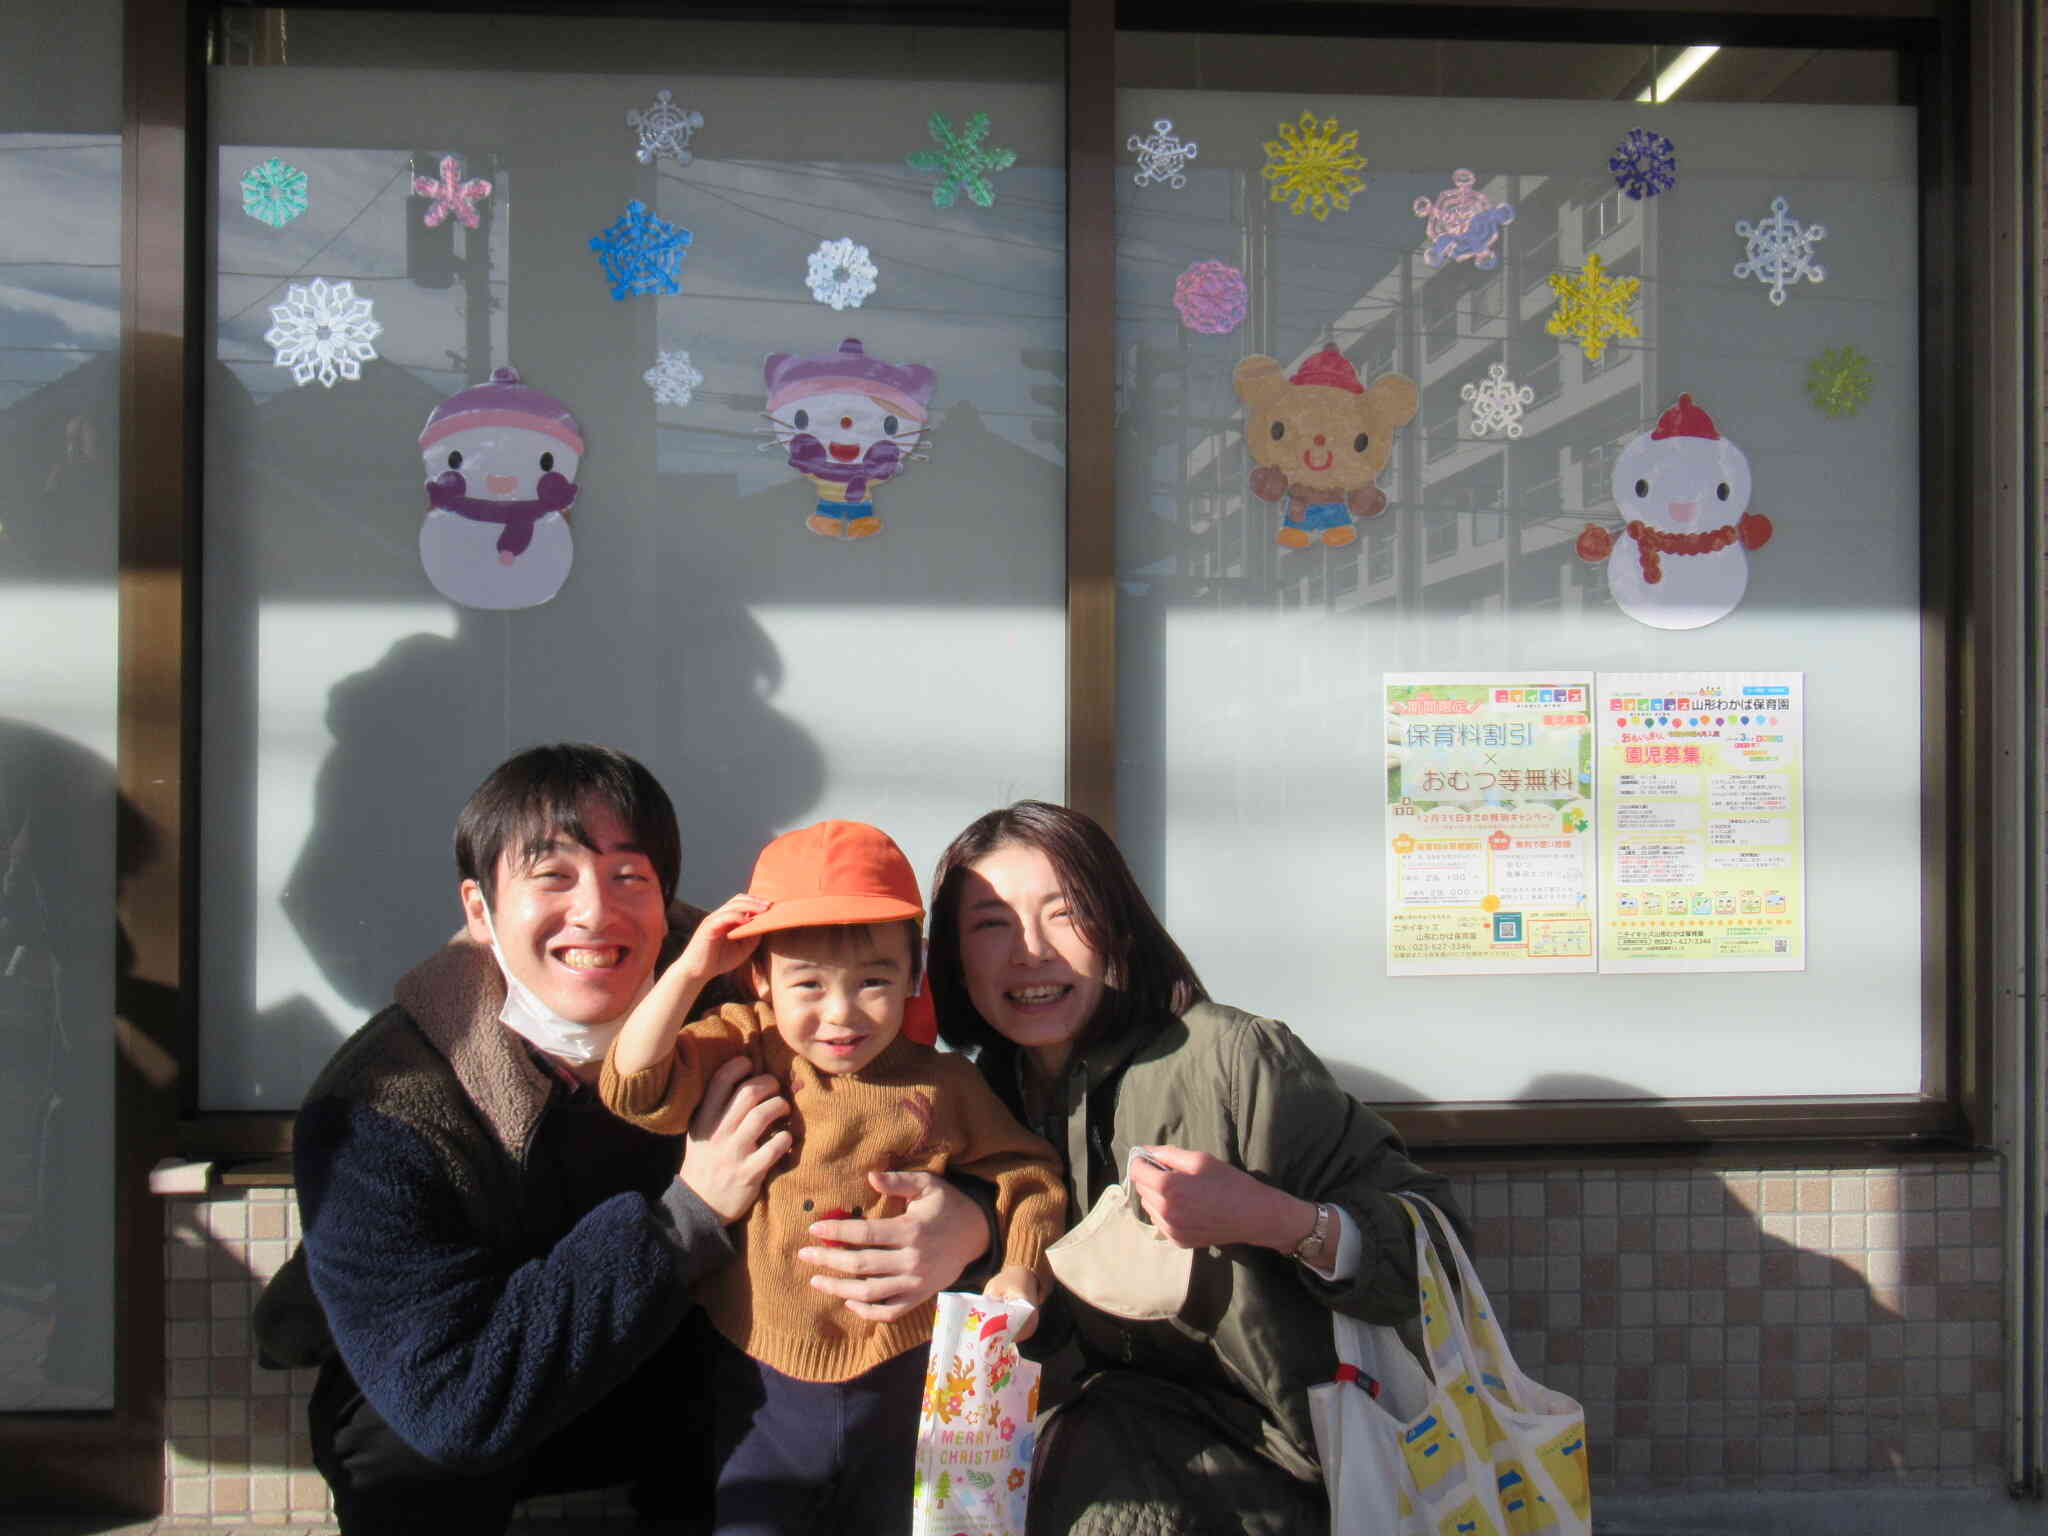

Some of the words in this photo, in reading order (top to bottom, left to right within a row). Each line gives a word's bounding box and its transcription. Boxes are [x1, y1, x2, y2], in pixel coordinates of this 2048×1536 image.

[1692, 698, 1790, 711] 山形わかば保育園
[1406, 722, 1533, 746] 保育料割引
[1625, 746, 1701, 764] 園児募集
[1421, 768, 1573, 792] おむつ等無料
[942, 1431, 992, 1444] MERRY
